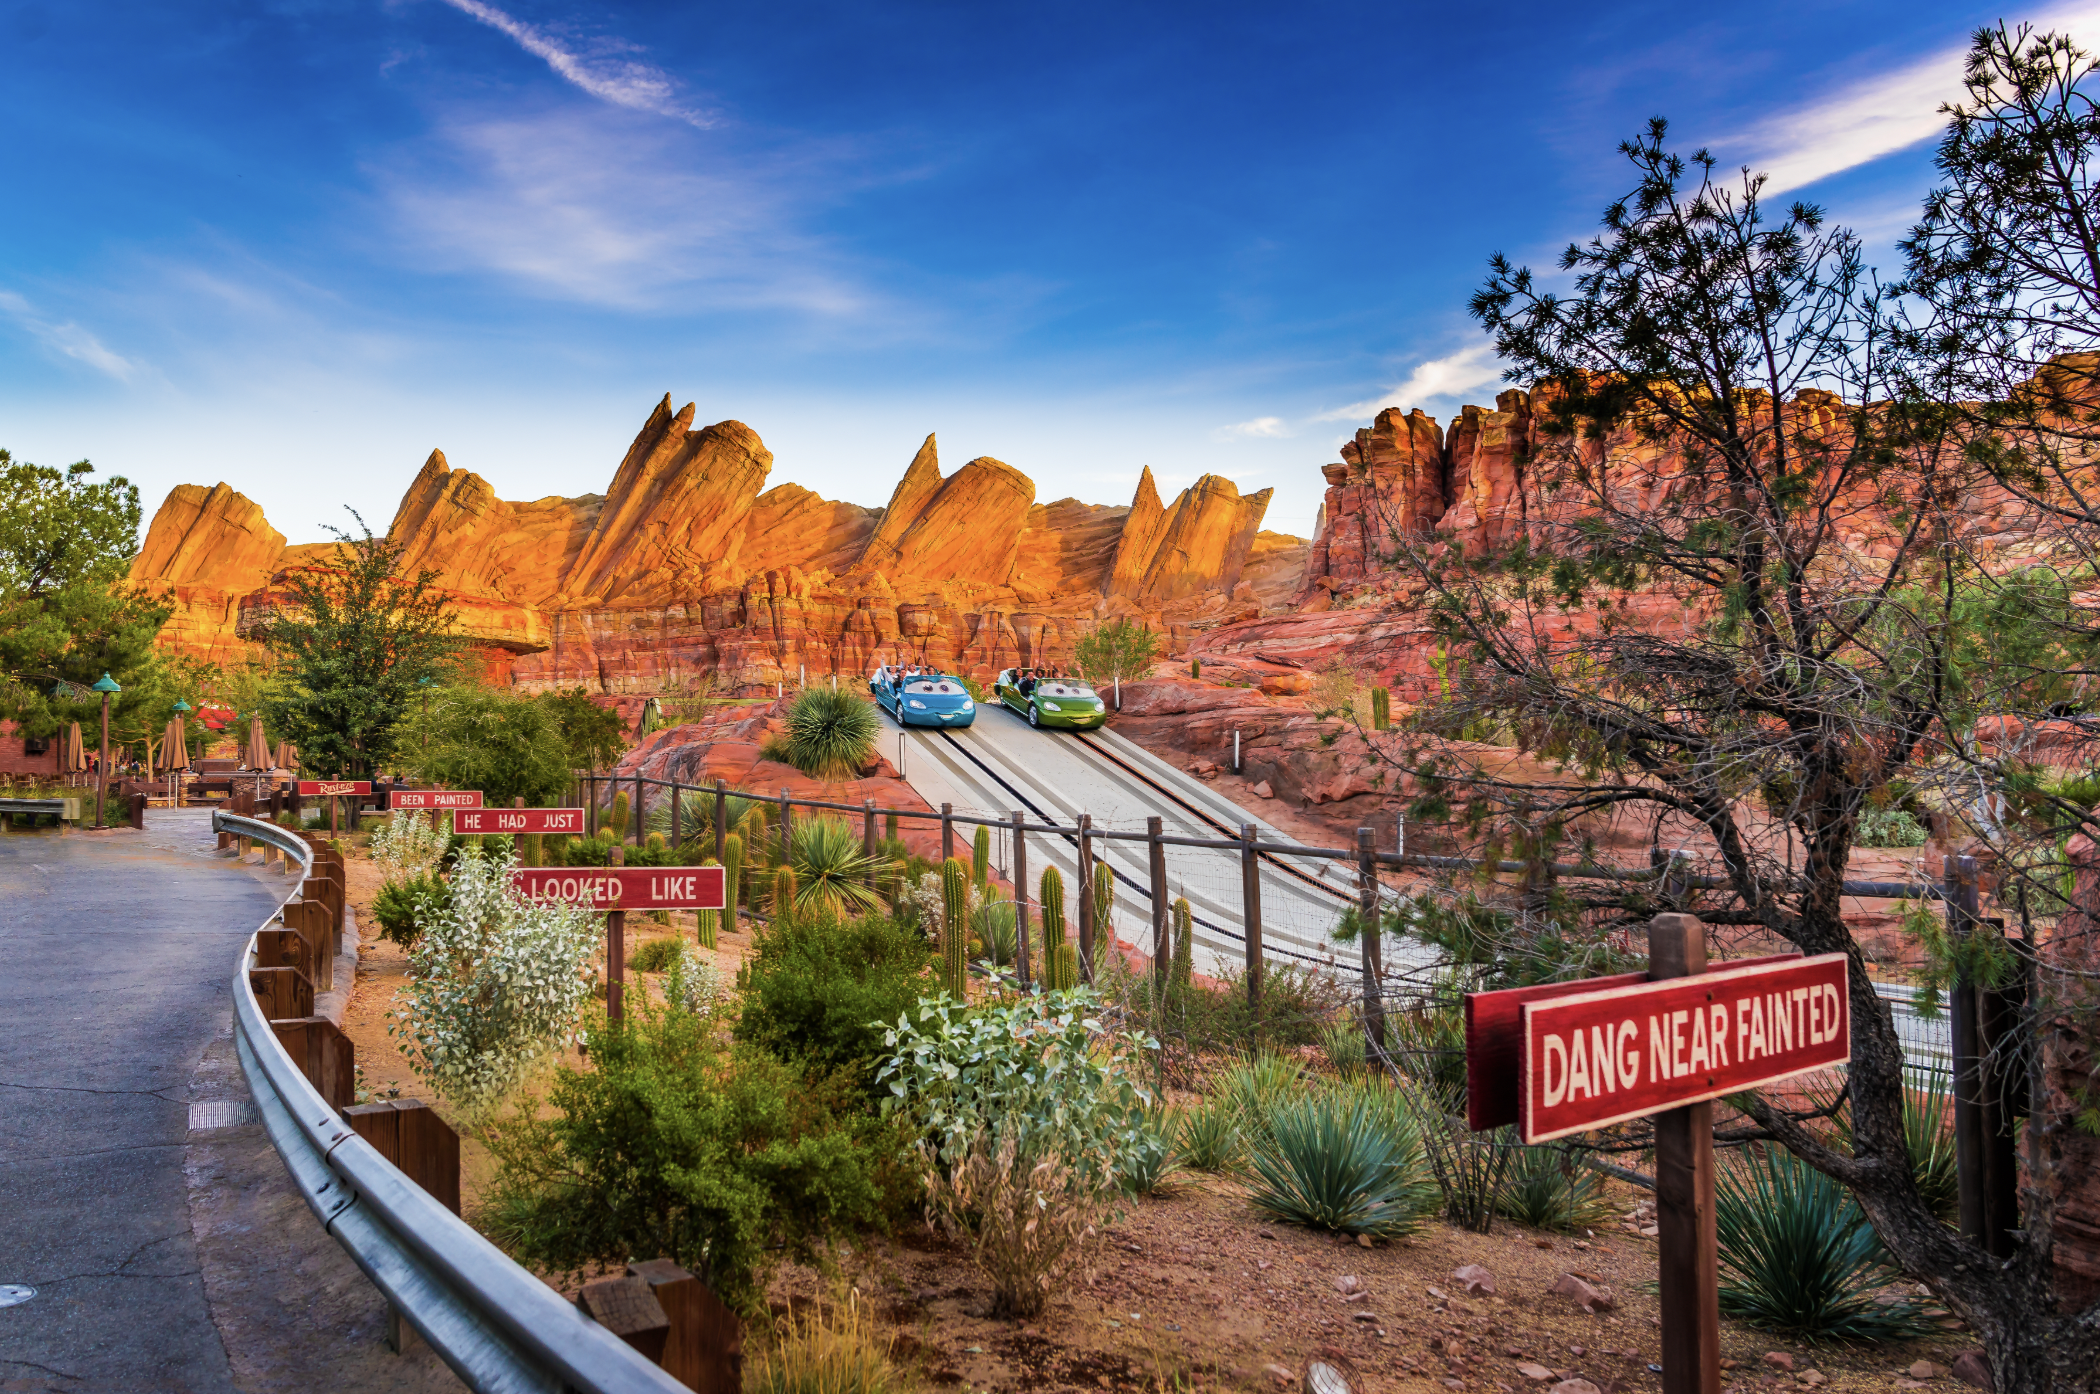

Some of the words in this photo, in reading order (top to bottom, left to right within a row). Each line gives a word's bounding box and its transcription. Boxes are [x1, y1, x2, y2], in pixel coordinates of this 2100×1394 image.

[400, 794, 425, 805] BEEN
[434, 794, 474, 805] PAINTED
[464, 814, 482, 829] HE
[498, 814, 527, 829] HAD
[543, 813, 574, 828] JUST
[531, 877, 623, 902] LOOKED
[651, 876, 697, 900] LIKE
[1542, 1019, 1640, 1108] DANG
[1649, 1003, 1729, 1083] NEAR
[1736, 982, 1841, 1062] FAINTED
